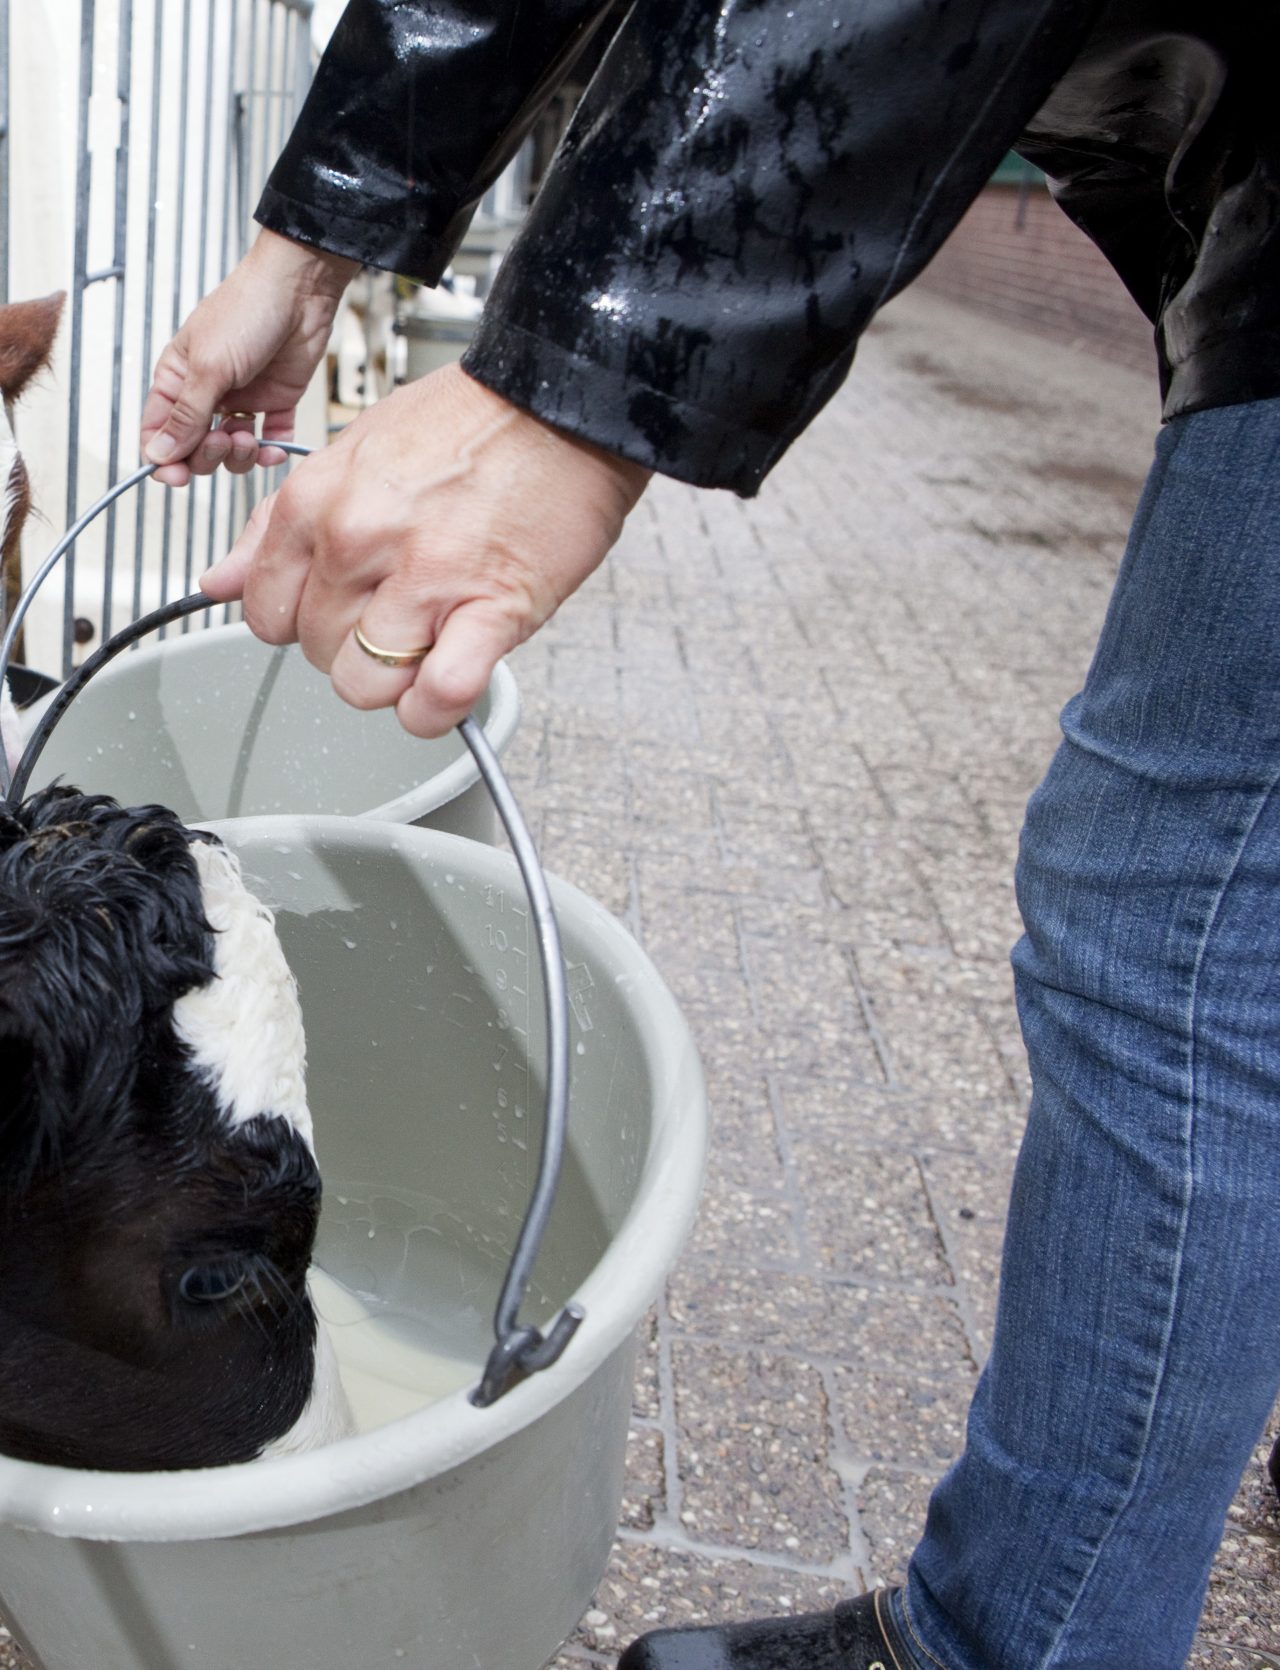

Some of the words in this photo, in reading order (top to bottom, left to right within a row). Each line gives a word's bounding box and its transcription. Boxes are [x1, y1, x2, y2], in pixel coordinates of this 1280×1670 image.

[484, 923, 509, 953] 10
[494, 967, 509, 992] 9
[496, 1086, 509, 1109] 6
[496, 1121, 509, 1145] 5
